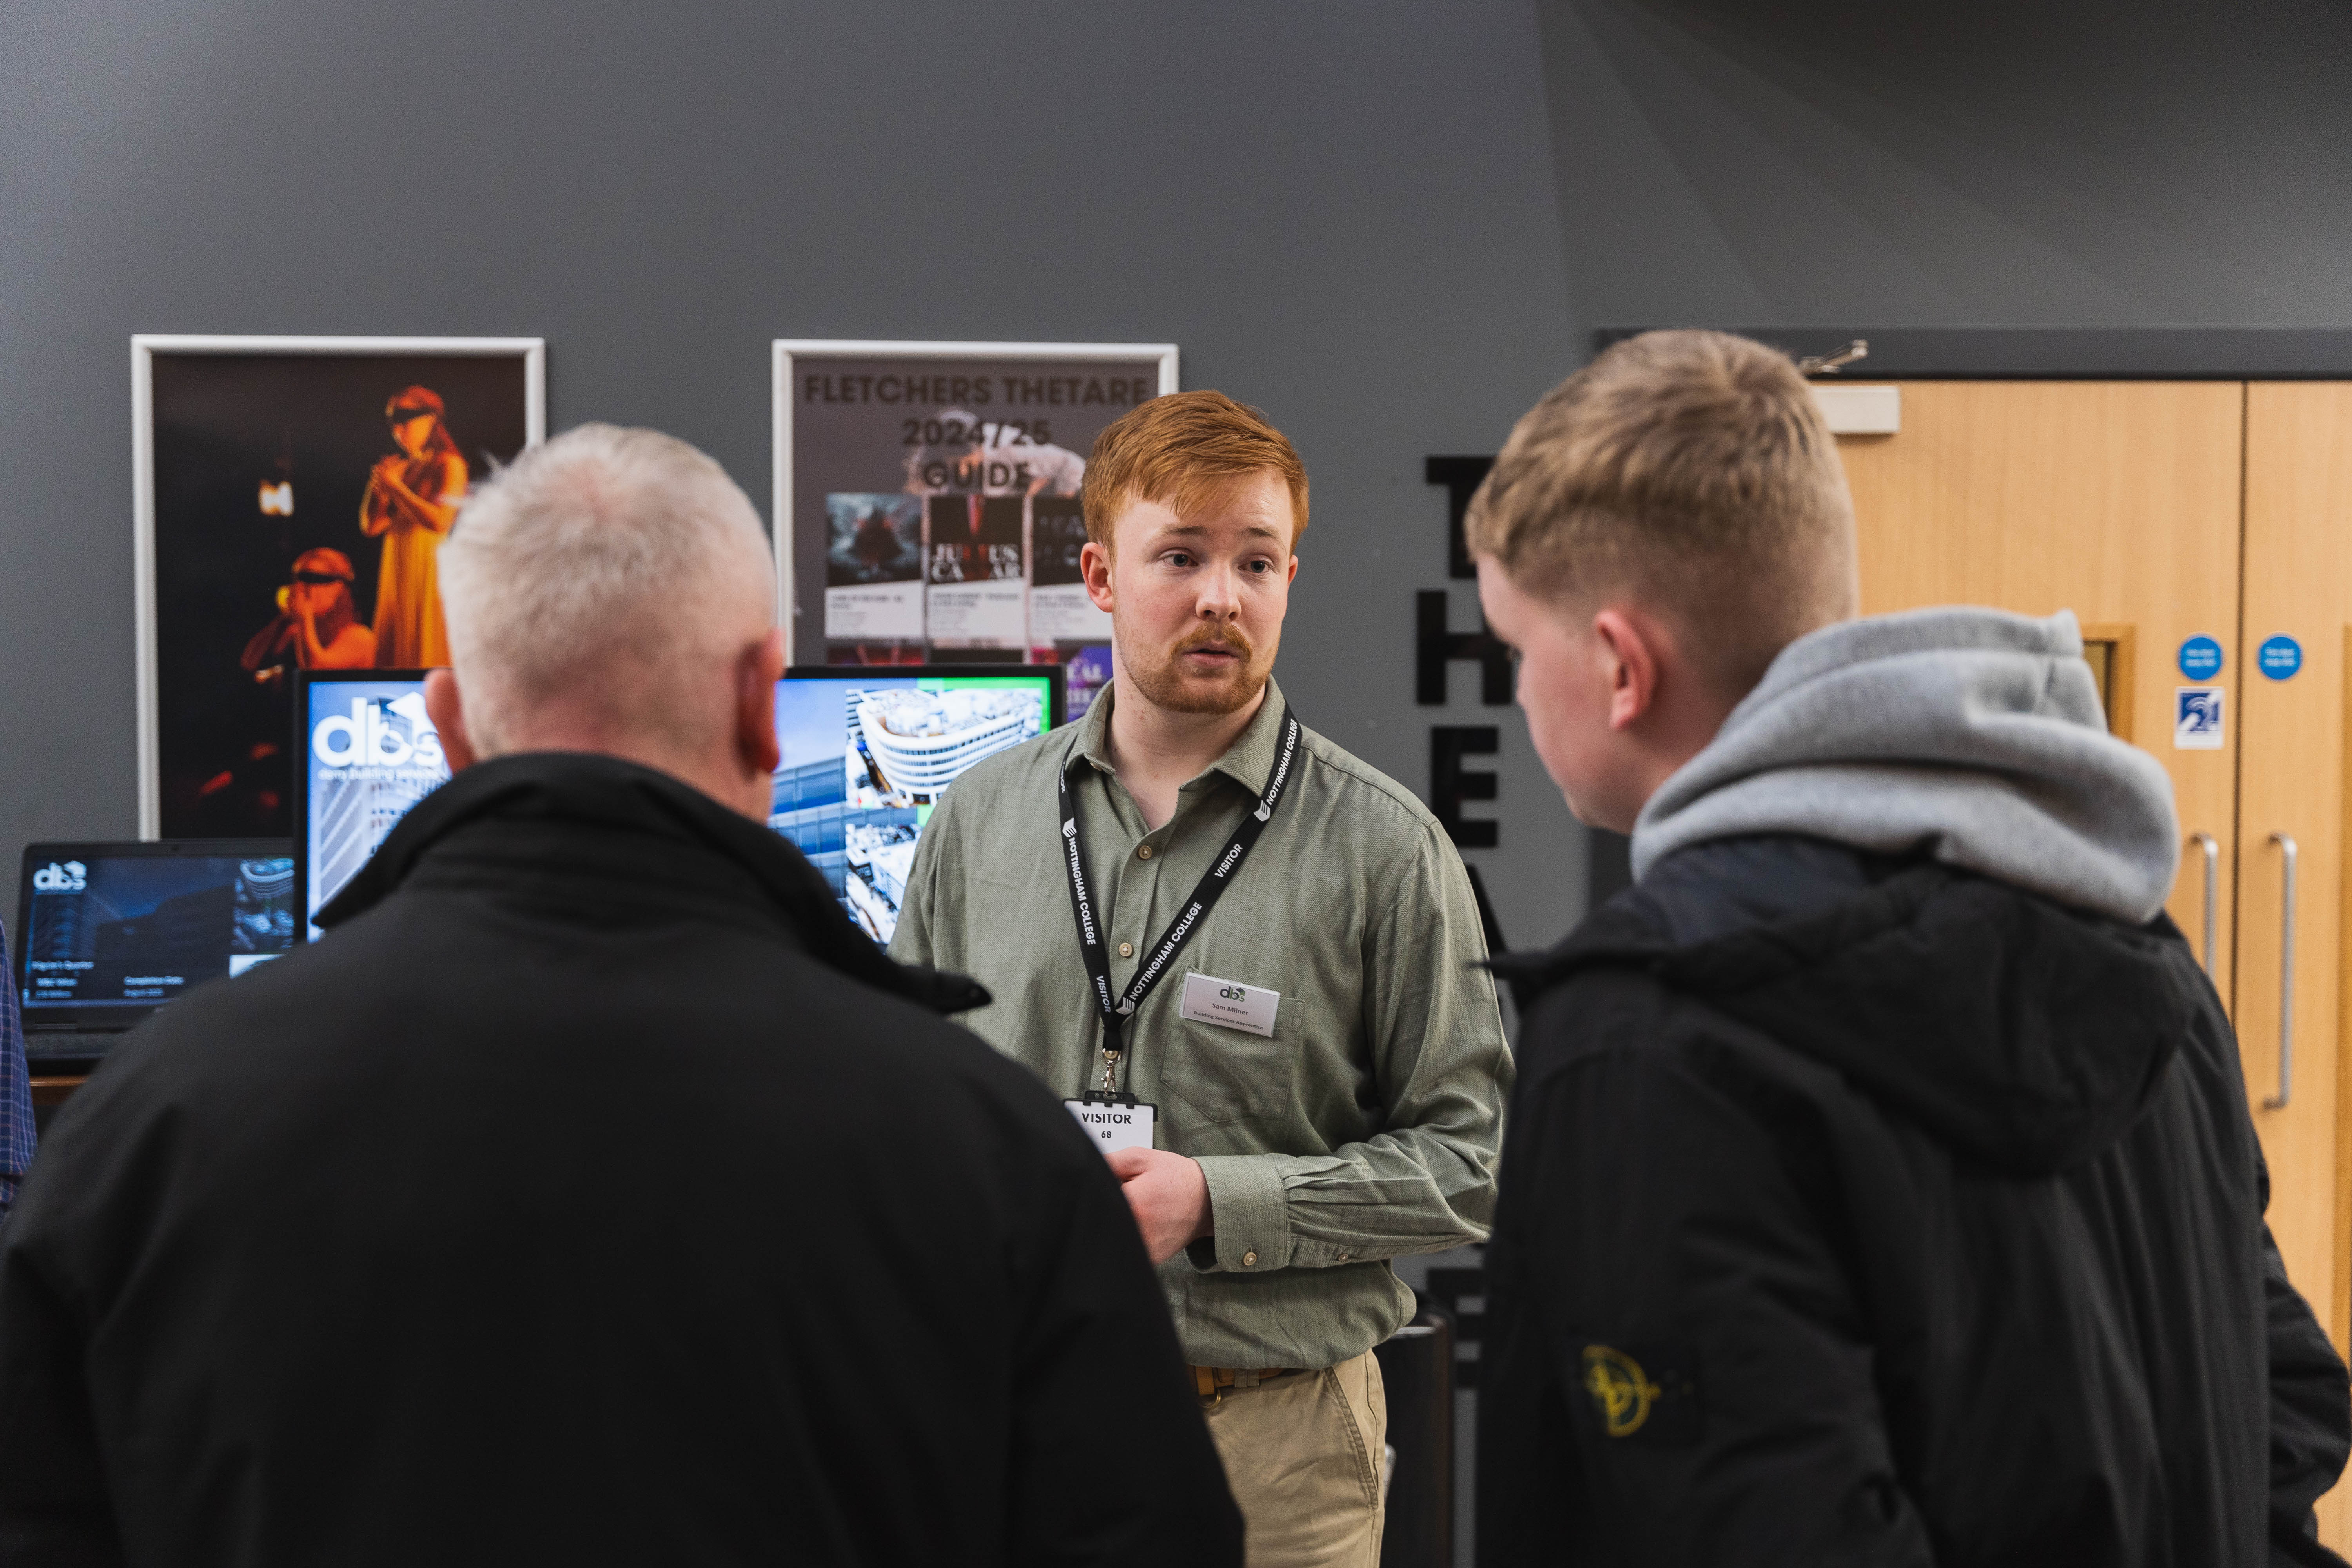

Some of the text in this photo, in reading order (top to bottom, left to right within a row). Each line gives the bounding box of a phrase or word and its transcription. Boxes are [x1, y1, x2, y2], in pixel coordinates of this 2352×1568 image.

[805, 375, 1147, 406] FLETCHERS THETARE
[903, 418, 1051, 447] 2024/25
[923, 462, 1032, 489] GUIDE
[1266, 718, 1298, 805] NOTTINGHAM COLLEGE
[1214, 844, 1243, 877] VISITOR
[1069, 837, 1096, 945] NOTTINGHAM COLLEGE
[1129, 902, 1203, 1000] NOTTINGHAM COLLEGE
[1096, 975, 1111, 1013] VISITOR
[1220, 986, 1245, 1002] dbs
[1194, 1011, 1214, 1019] Building
[1236, 1020, 1263, 1030] Apprentice
[1227, 1007, 1249, 1015] Milner
[1082, 1113, 1132, 1124] VISITOR
